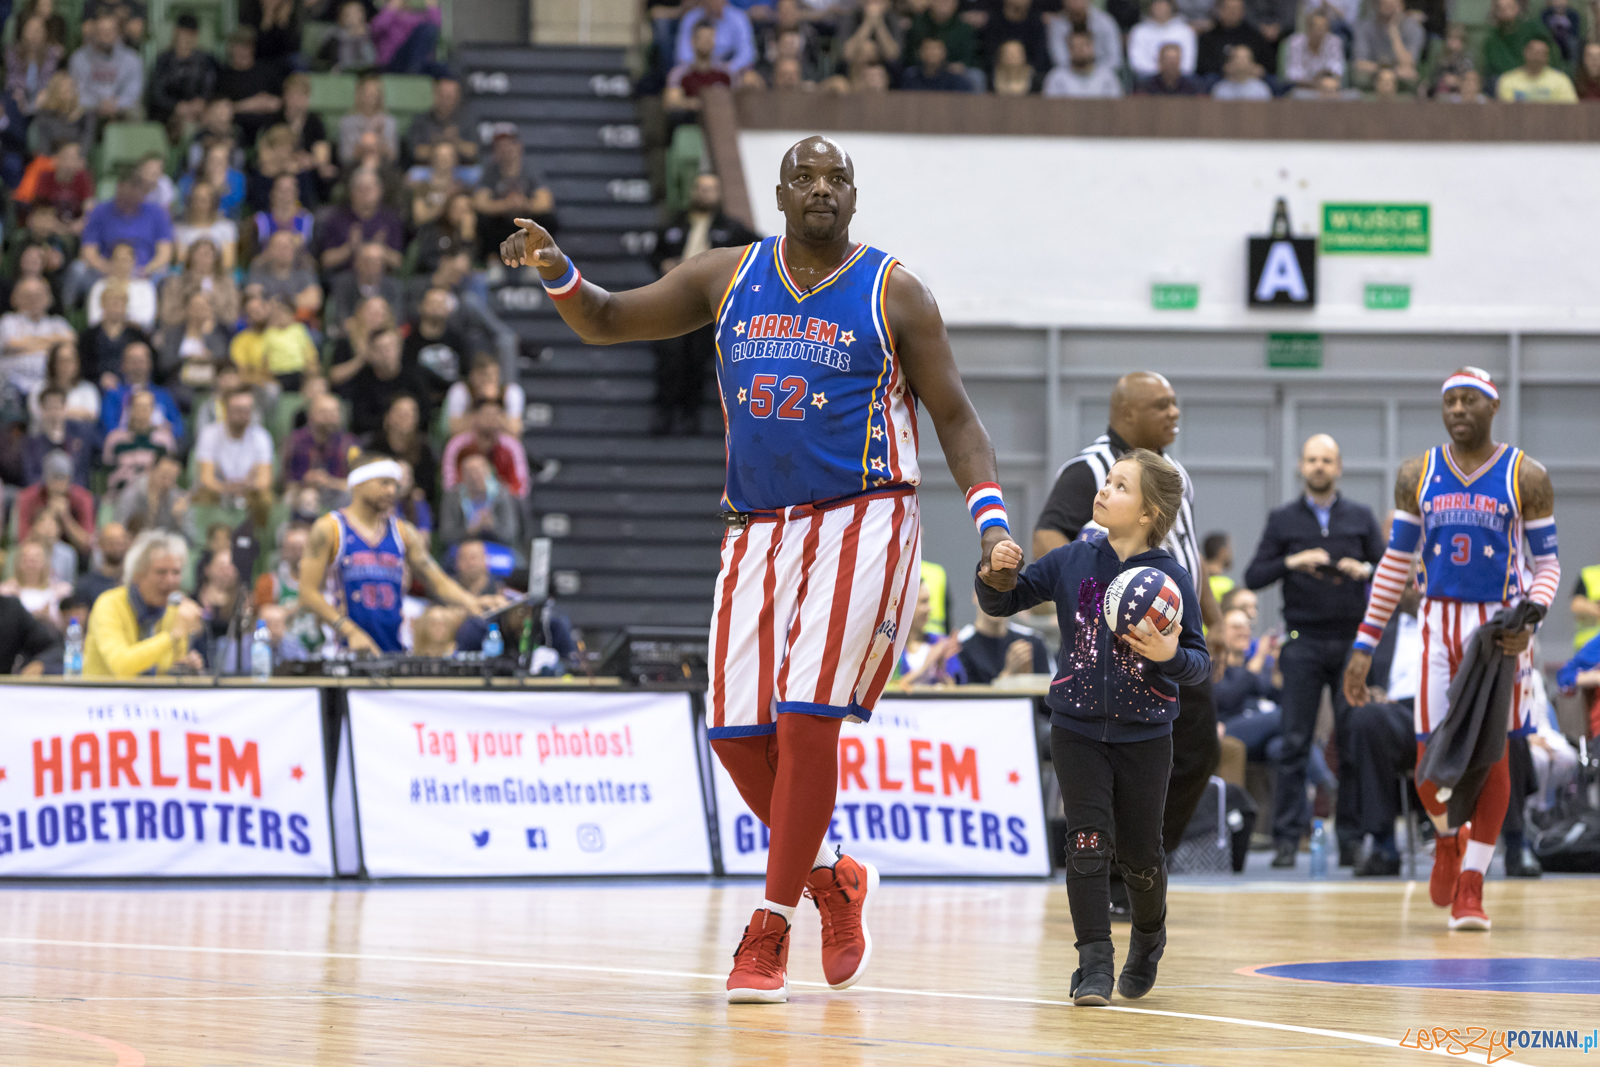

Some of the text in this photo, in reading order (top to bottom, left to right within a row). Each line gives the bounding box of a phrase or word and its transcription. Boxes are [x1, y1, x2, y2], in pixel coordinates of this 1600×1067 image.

[1255, 241, 1308, 301] A
[748, 314, 839, 346] HARLEM
[731, 340, 851, 372] GLOBETROTTERS
[749, 374, 808, 420] 52
[1432, 492, 1498, 514] HARLEM
[1451, 533, 1471, 565] 3
[32, 729, 262, 799] HARLEM
[412, 722, 634, 764] Tag your photos!
[839, 736, 981, 802] RLEM
[410, 777, 653, 806] #HarlemGlobetrotters
[0, 799, 312, 856] GLOBETROTTERS
